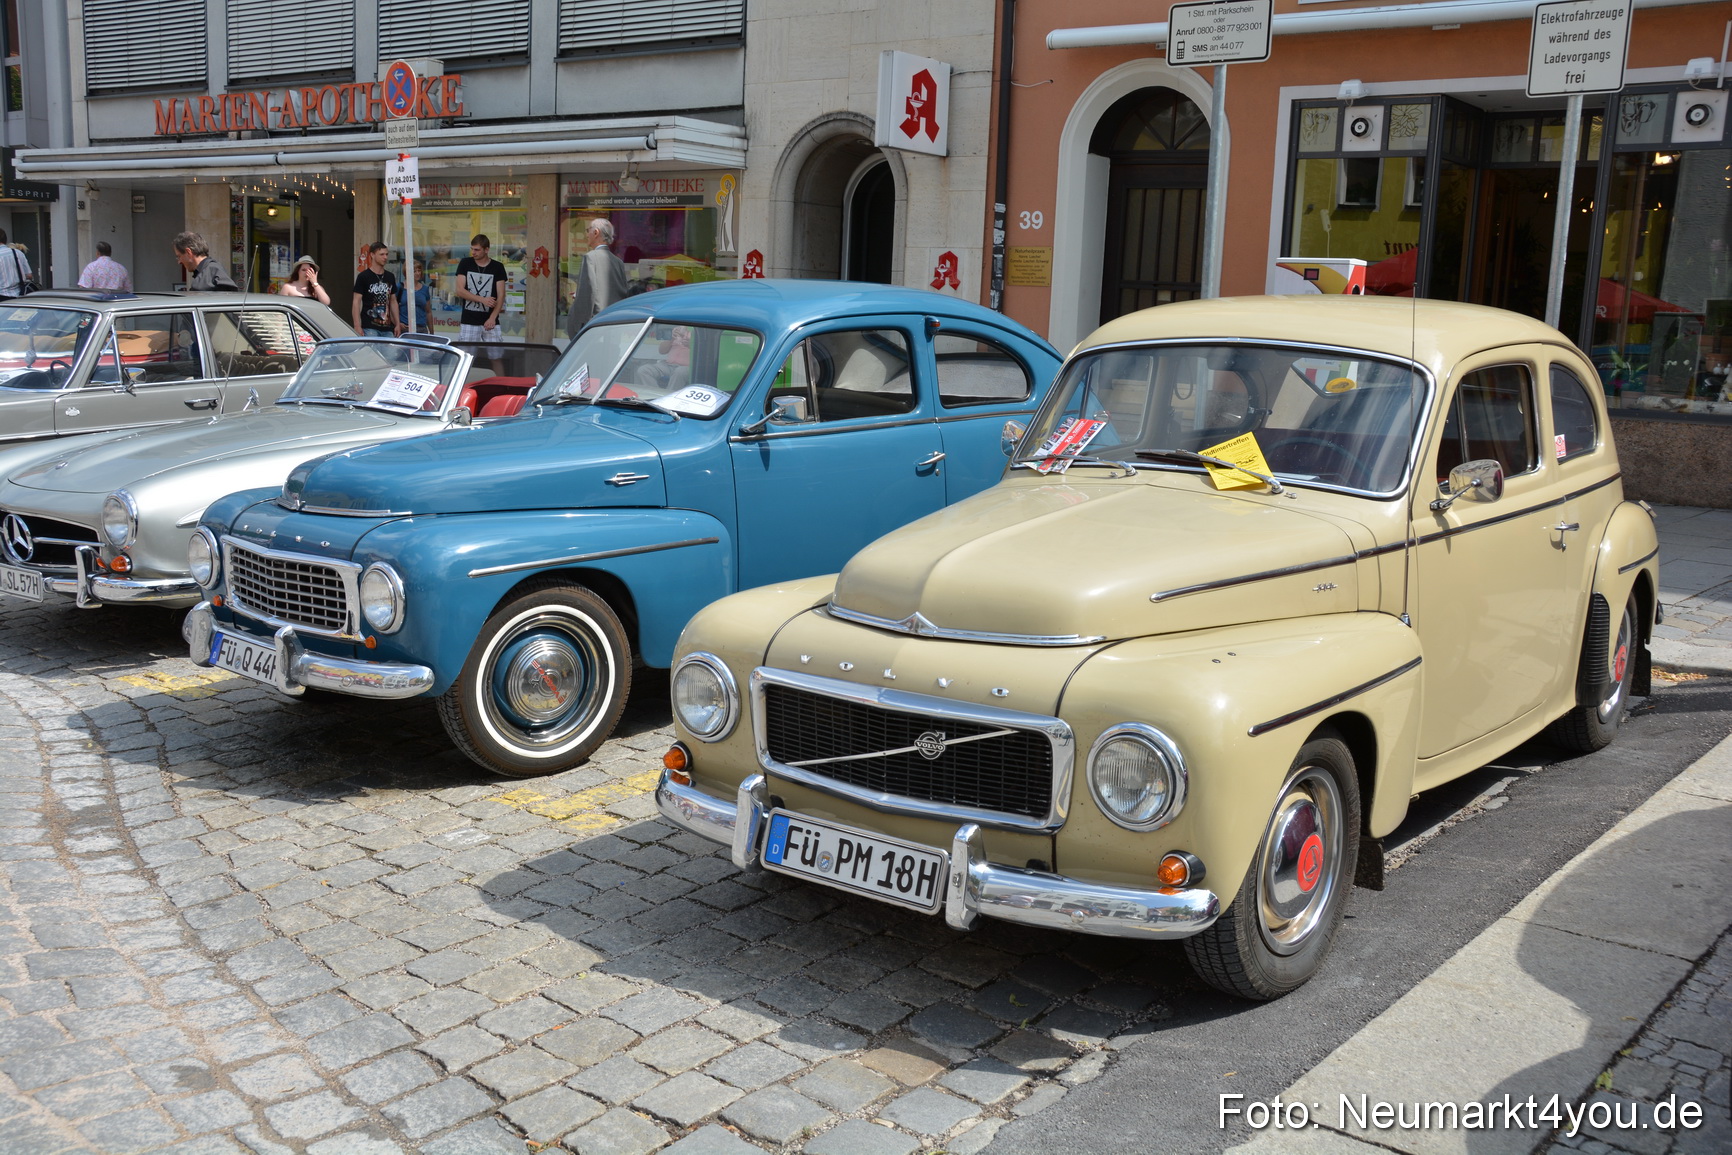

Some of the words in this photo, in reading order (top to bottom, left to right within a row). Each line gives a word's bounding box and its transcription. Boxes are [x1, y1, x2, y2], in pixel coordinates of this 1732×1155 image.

[1219, 5, 1254, 16] Parkschein
[1540, 8, 1624, 25] Elektrofahrzeuge
[1176, 28, 1196, 36] Anruf
[1549, 29, 1590, 44] während
[1594, 29, 1611, 40] des
[1191, 44, 1208, 53] SMS
[1544, 51, 1611, 65] Ladevorgangs
[1565, 70, 1586, 84] frei
[153, 74, 464, 135] MARIEN-APOTHKE
[387, 175, 416, 185] 07.06.2015
[10, 188, 51, 199] ESPRIT
[614, 196, 635, 205] werden,
[635, 196, 655, 206] gesund
[655, 195, 678, 204] bleiben!
[1019, 210, 1044, 230] 39
[404, 381, 423, 393] 504
[685, 390, 712, 403] 399
[7, 571, 19, 592] SL
[20, 573, 39, 596] 57H
[217, 637, 238, 667] FÜ
[242, 646, 254, 673] Q
[800, 654, 1011, 698] VOLVO
[916, 740, 945, 752] VOLVO
[771, 843, 779, 855] D
[783, 825, 821, 868] FÜ
[834, 837, 874, 883] PM
[877, 850, 939, 900] 18H
